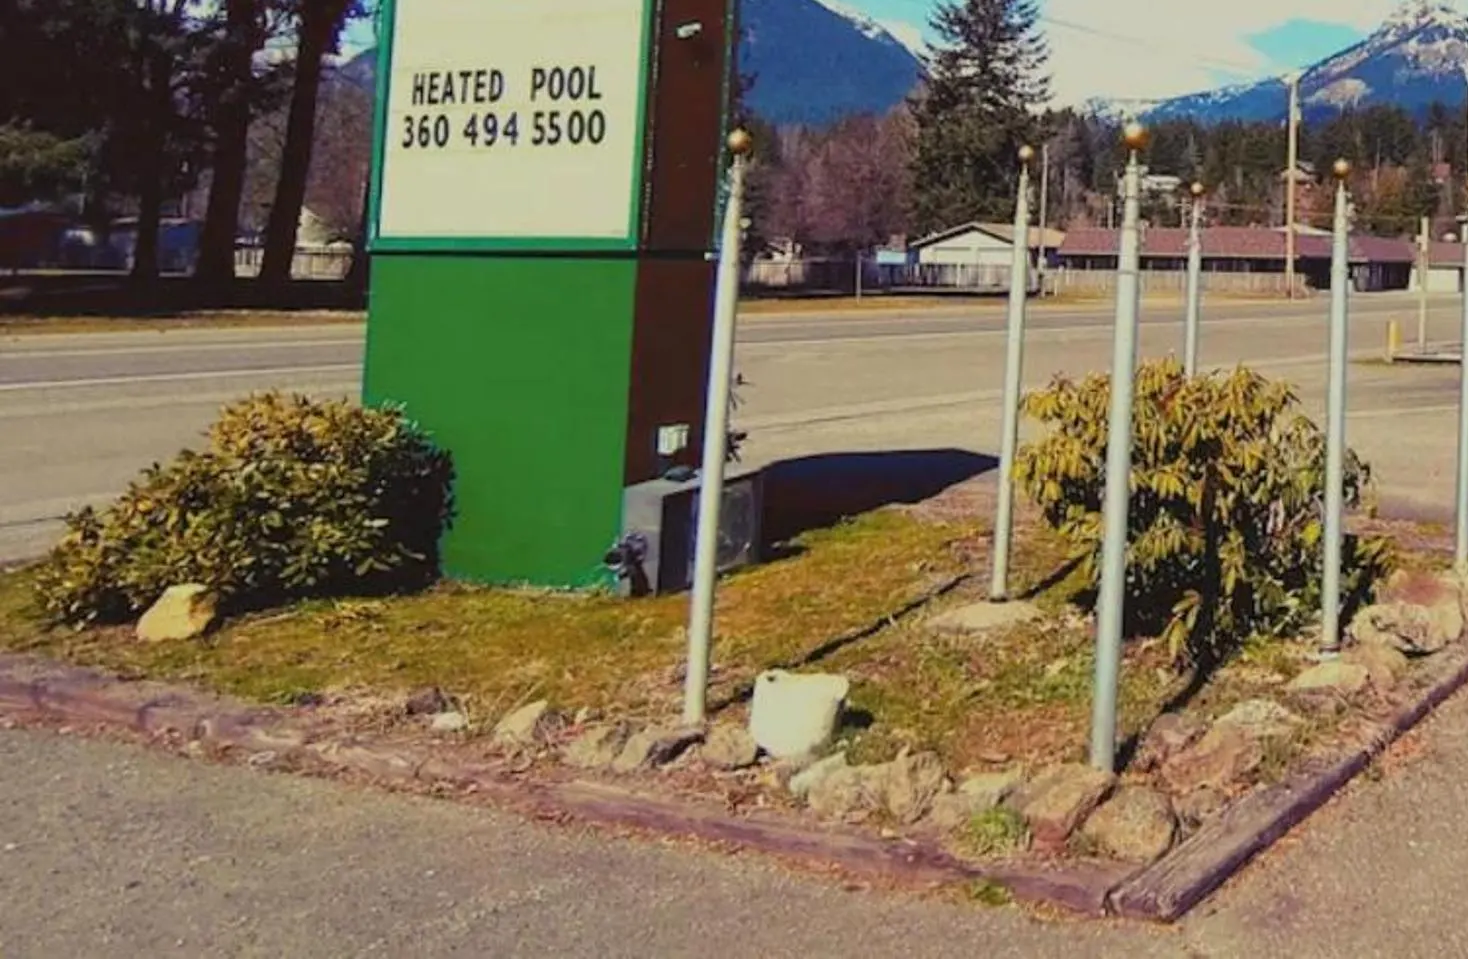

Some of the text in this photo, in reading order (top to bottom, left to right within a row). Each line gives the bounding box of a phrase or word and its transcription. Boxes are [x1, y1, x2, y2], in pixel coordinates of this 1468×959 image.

[412, 65, 602, 105] HEATED POOL
[402, 109, 606, 148] 360 494 5500
